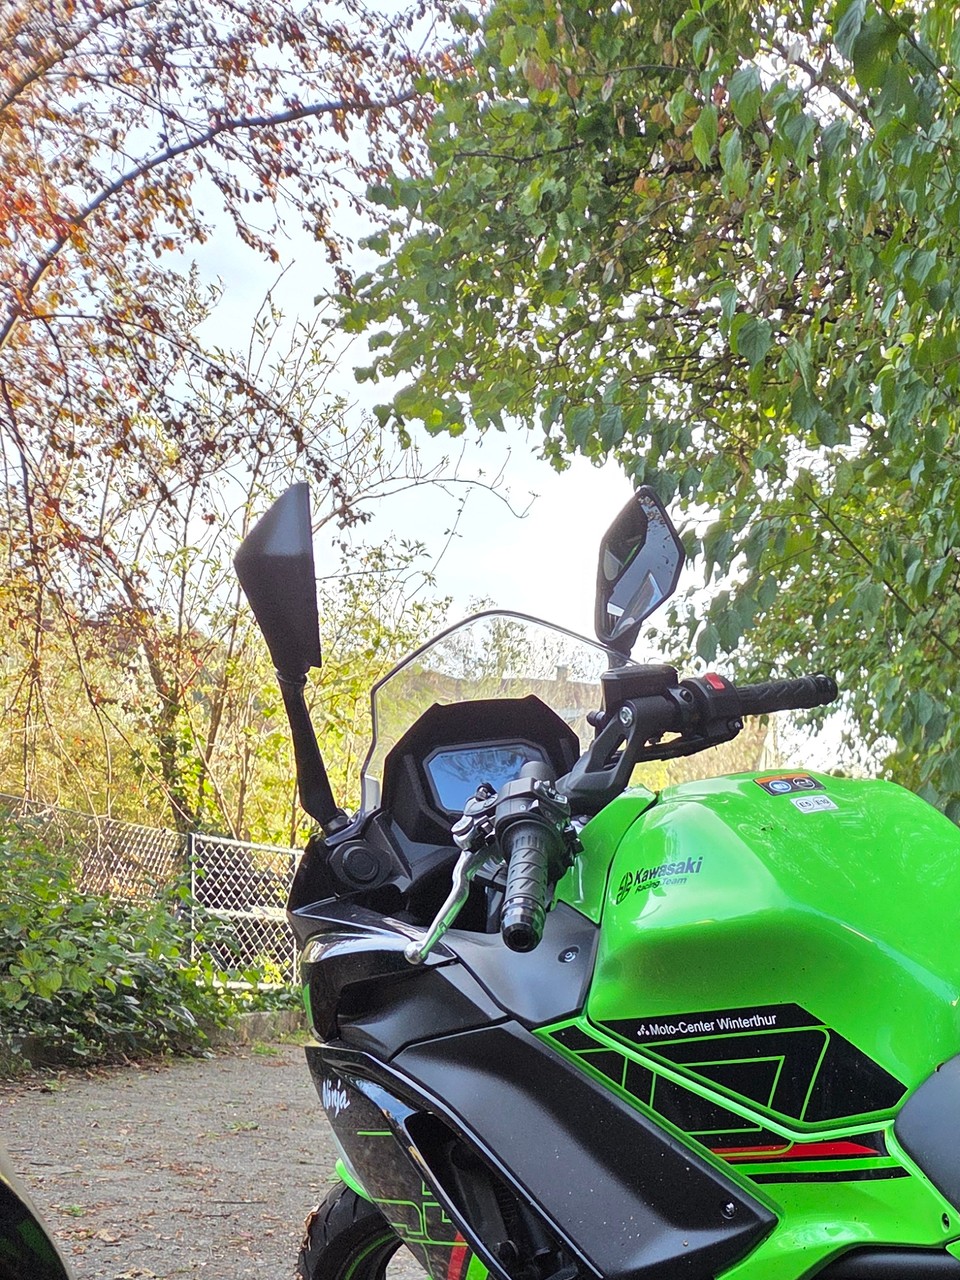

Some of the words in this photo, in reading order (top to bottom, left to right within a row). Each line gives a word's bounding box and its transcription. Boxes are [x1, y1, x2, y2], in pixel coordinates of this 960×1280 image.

[633, 856, 703, 886] Kawasaki
[635, 880, 660, 894] Racing
[662, 877, 688, 886] Team
[649, 1021, 714, 1036] Moto-Center
[716, 1014, 777, 1030] Winterthur
[322, 1078, 351, 1119] Ninja
